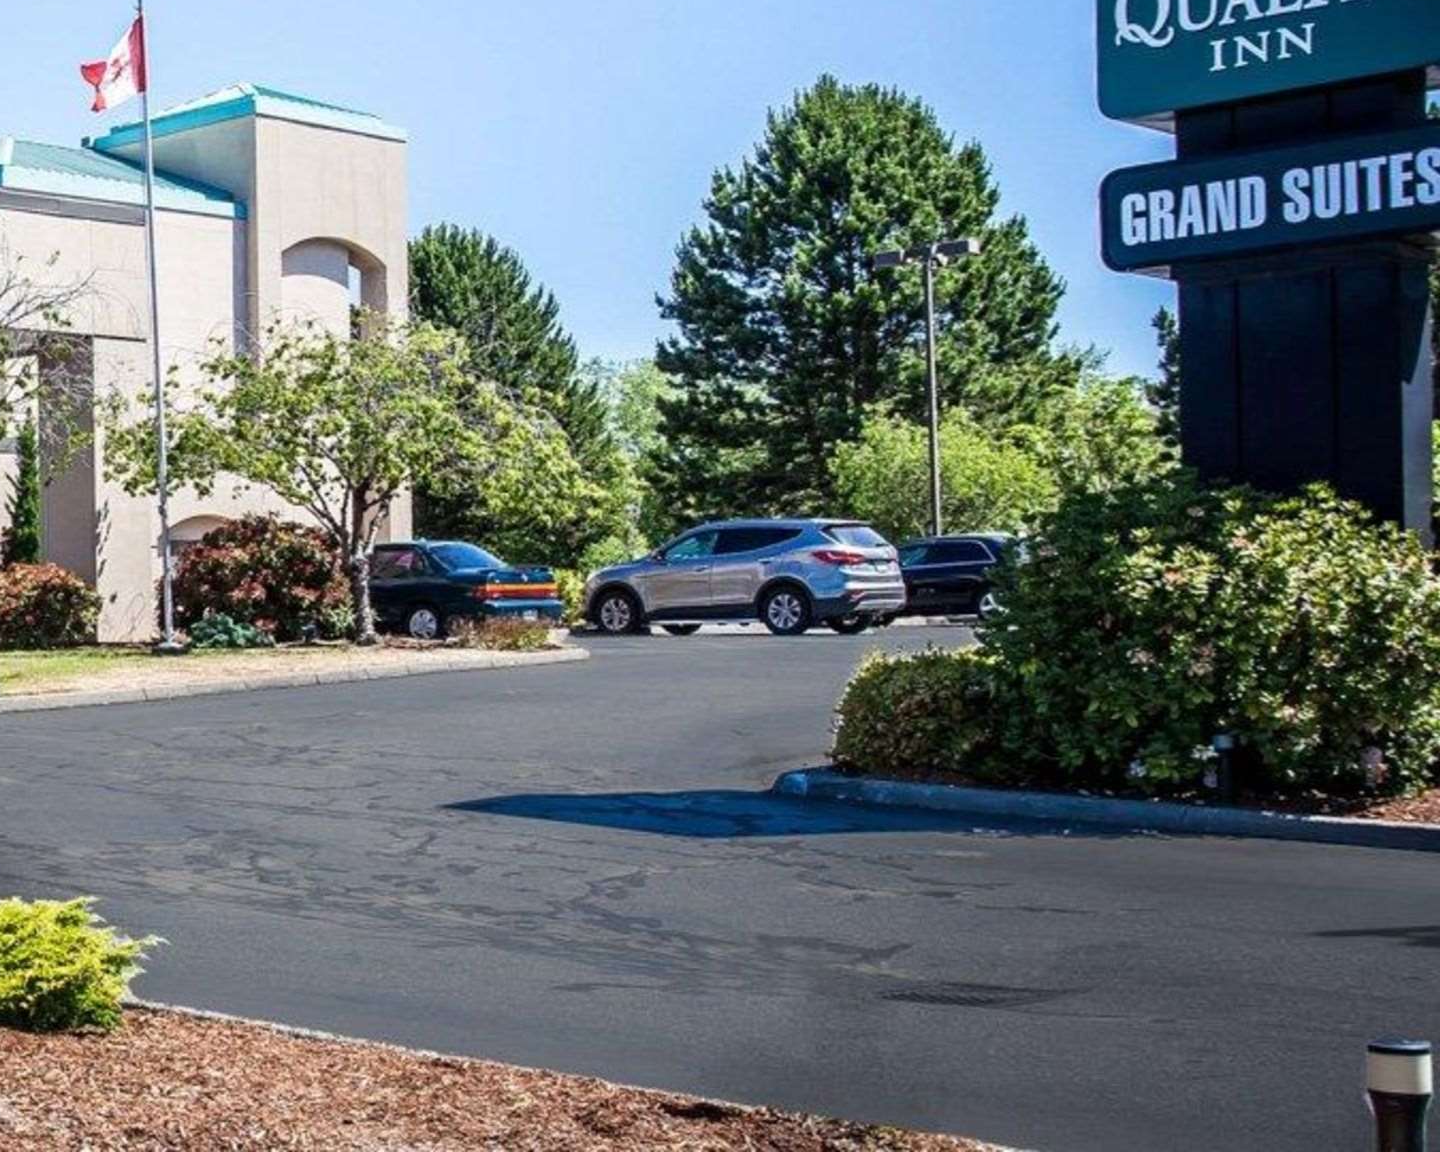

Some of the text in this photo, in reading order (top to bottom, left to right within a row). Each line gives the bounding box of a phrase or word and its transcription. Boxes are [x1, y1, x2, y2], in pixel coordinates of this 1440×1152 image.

[1209, 22, 1316, 73] INN
[1120, 147, 1440, 247] GRAND SUITES
